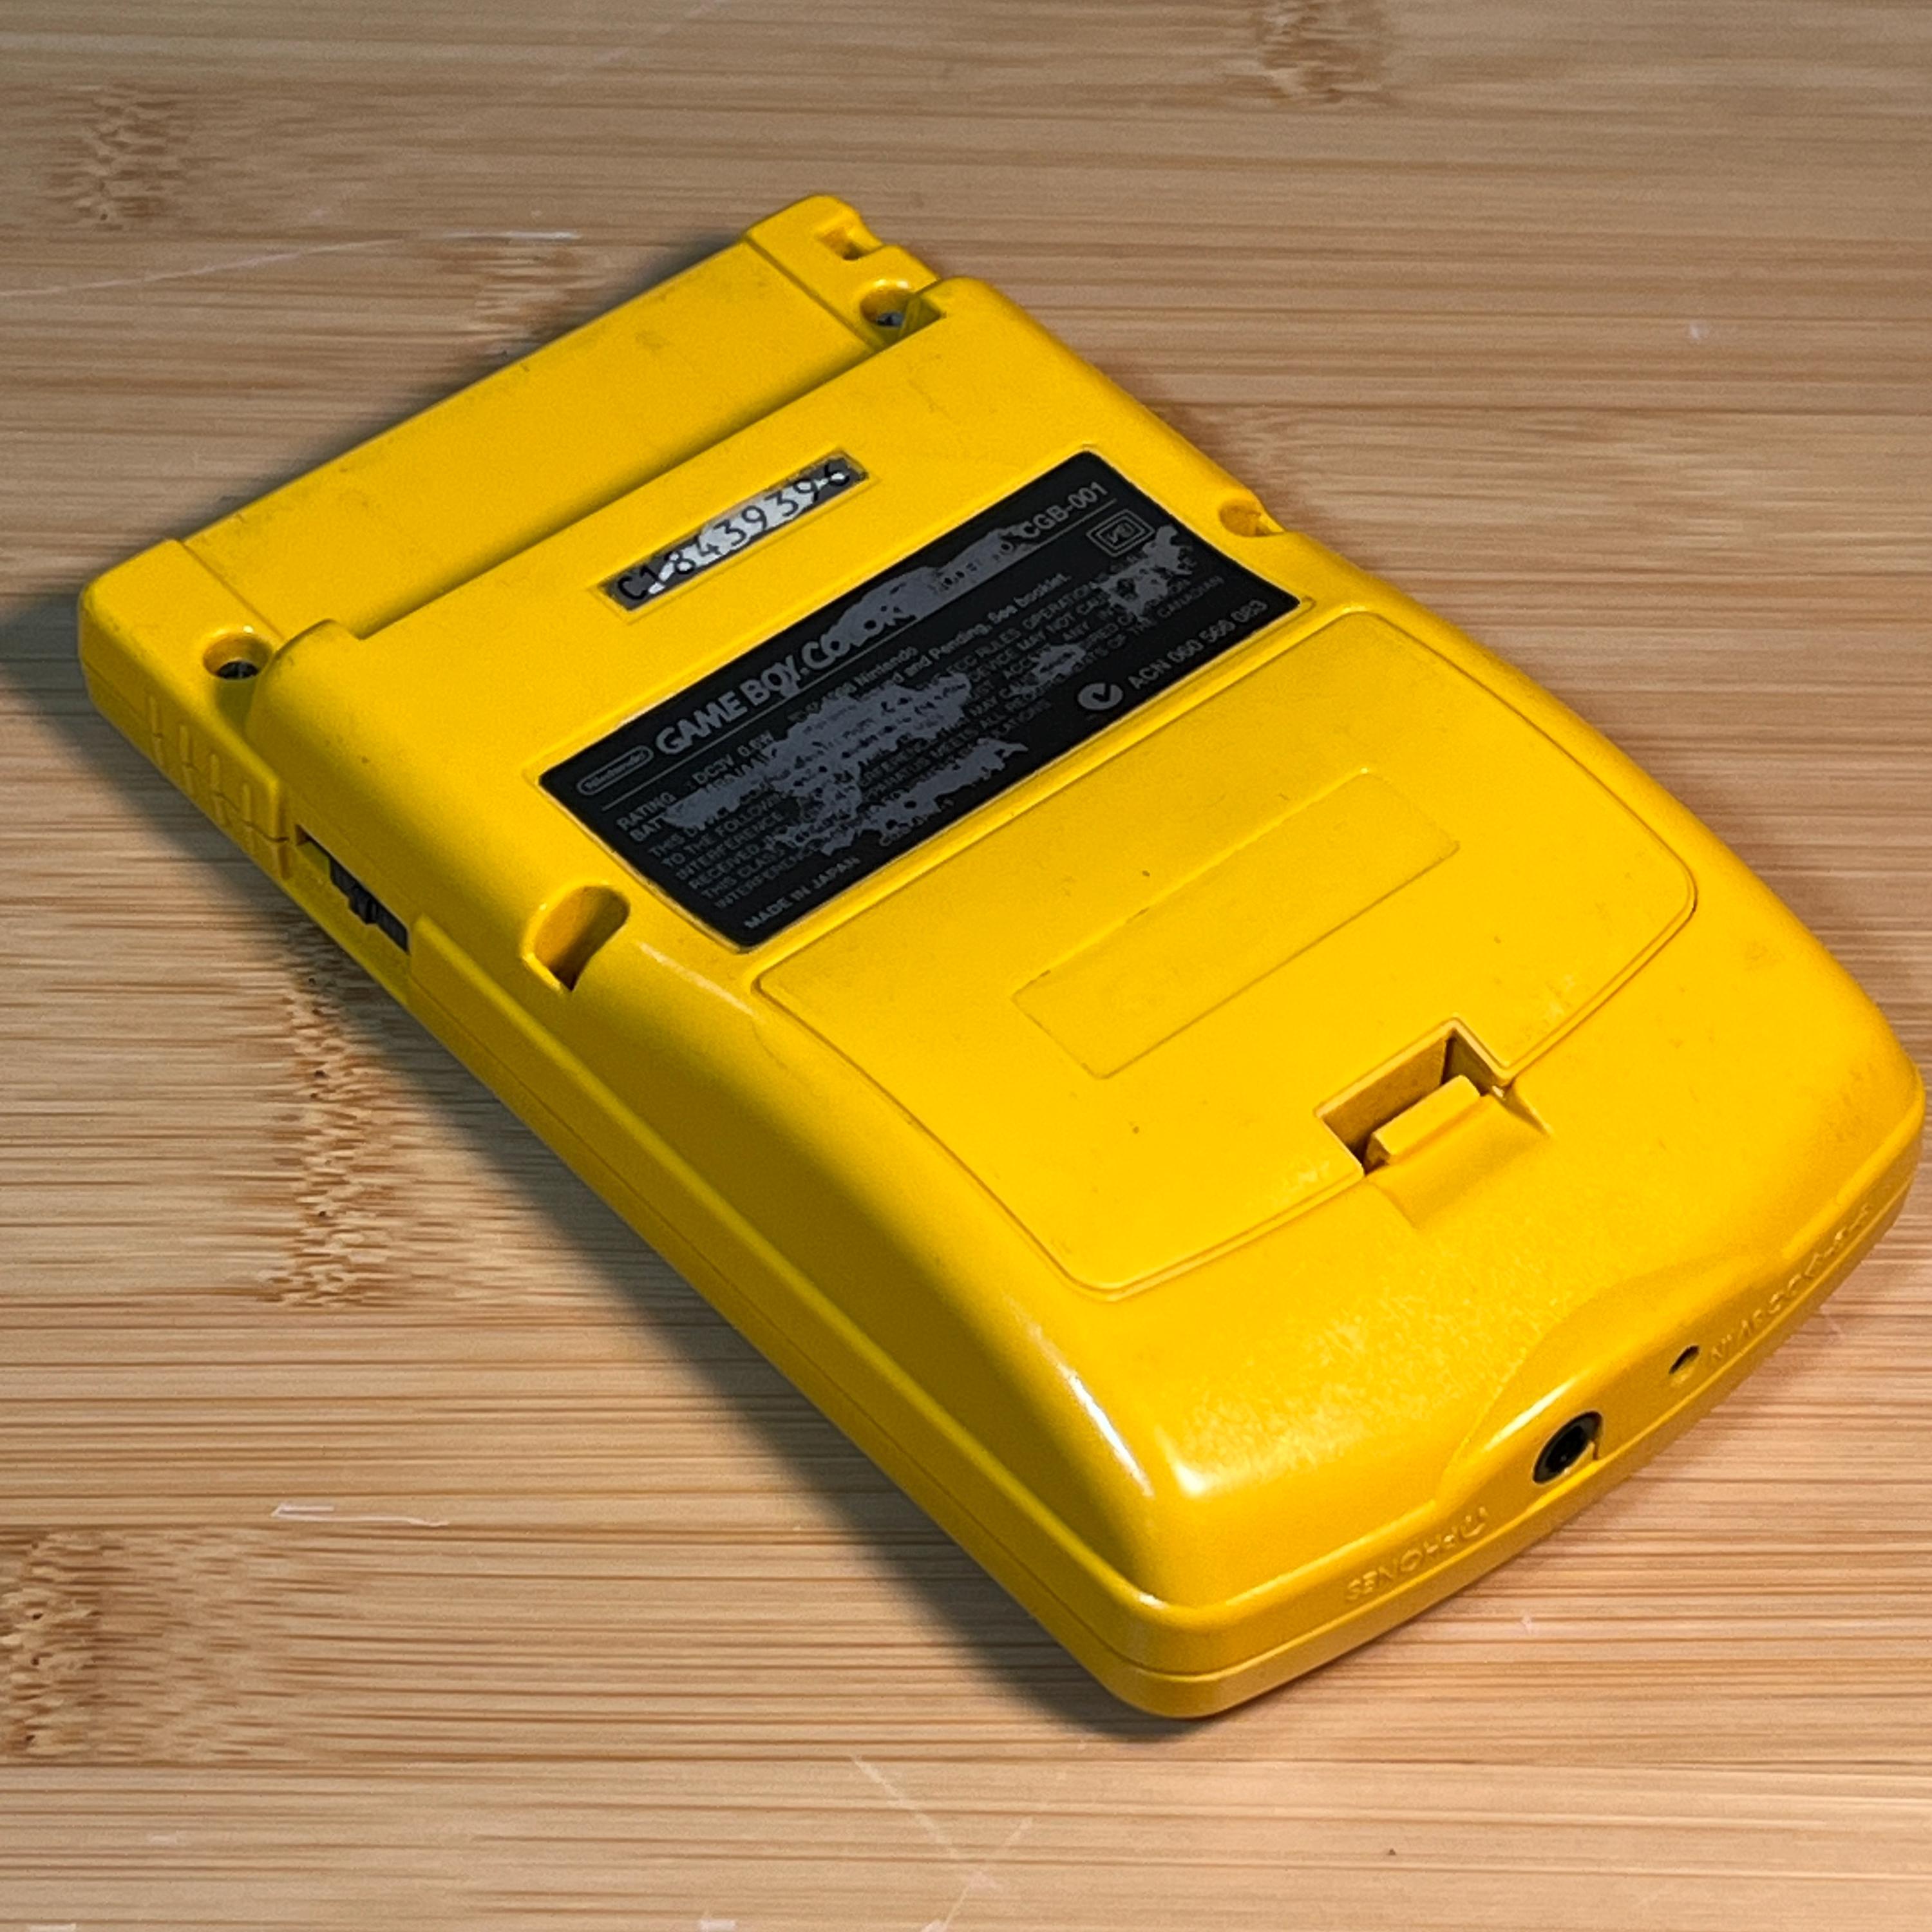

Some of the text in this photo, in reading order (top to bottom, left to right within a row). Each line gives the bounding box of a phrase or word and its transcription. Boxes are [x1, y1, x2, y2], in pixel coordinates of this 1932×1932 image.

[1015, 483, 1108, 538] CGB-001
[900, 655, 934, 676] and
[986, 603, 1018, 623] See
[1124, 658, 1173, 688] ACN
[649, 692, 752, 755] GAME
[735, 659, 806, 703] BOY
[614, 791, 677, 830] RATING
[743, 897, 793, 929] MADE
[808, 855, 862, 889] JAPAN
